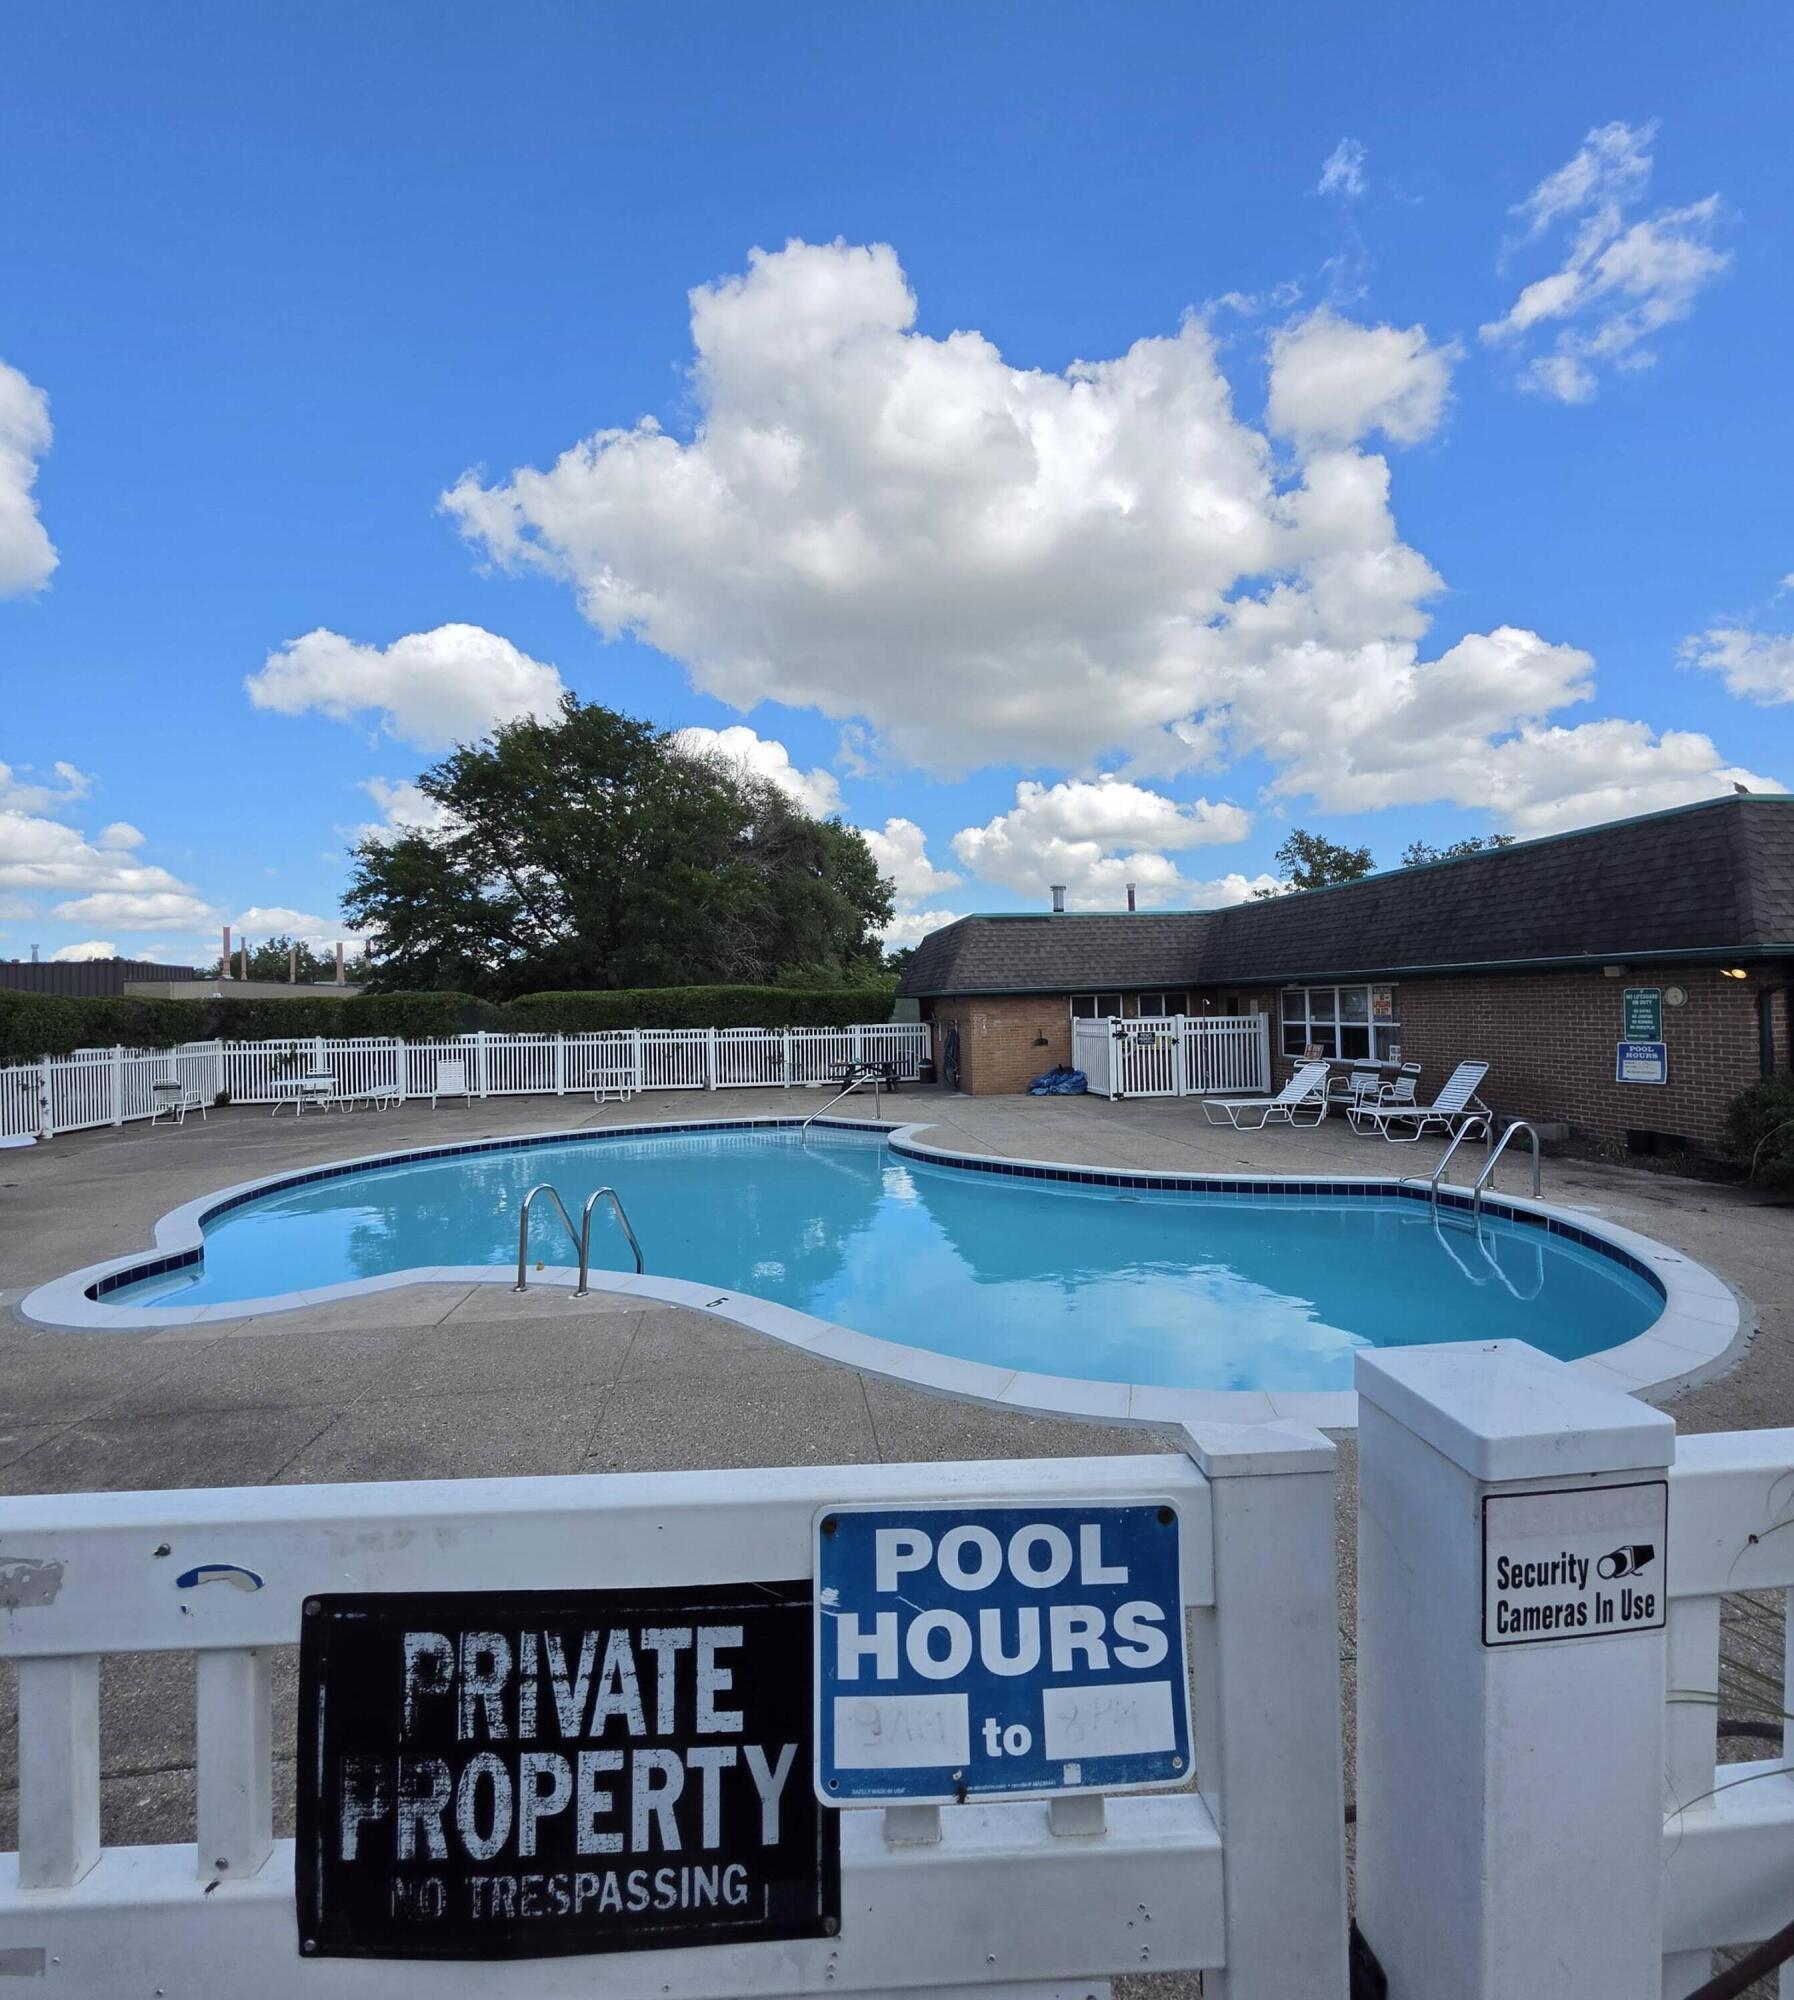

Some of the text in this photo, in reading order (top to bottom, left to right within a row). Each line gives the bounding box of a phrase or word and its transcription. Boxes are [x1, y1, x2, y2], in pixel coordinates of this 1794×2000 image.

[875, 1523, 1128, 1592] POOL
[1496, 1551, 1589, 1591] Security
[837, 1600, 1168, 1680] HOURS
[1496, 1588, 1655, 1634] Cameras In Use
[400, 1625, 744, 1742] PRIVATE
[982, 1717, 1032, 1757] to
[339, 1743, 798, 1862] PROPERTY
[465, 1864, 748, 1919] TRESPASSING
